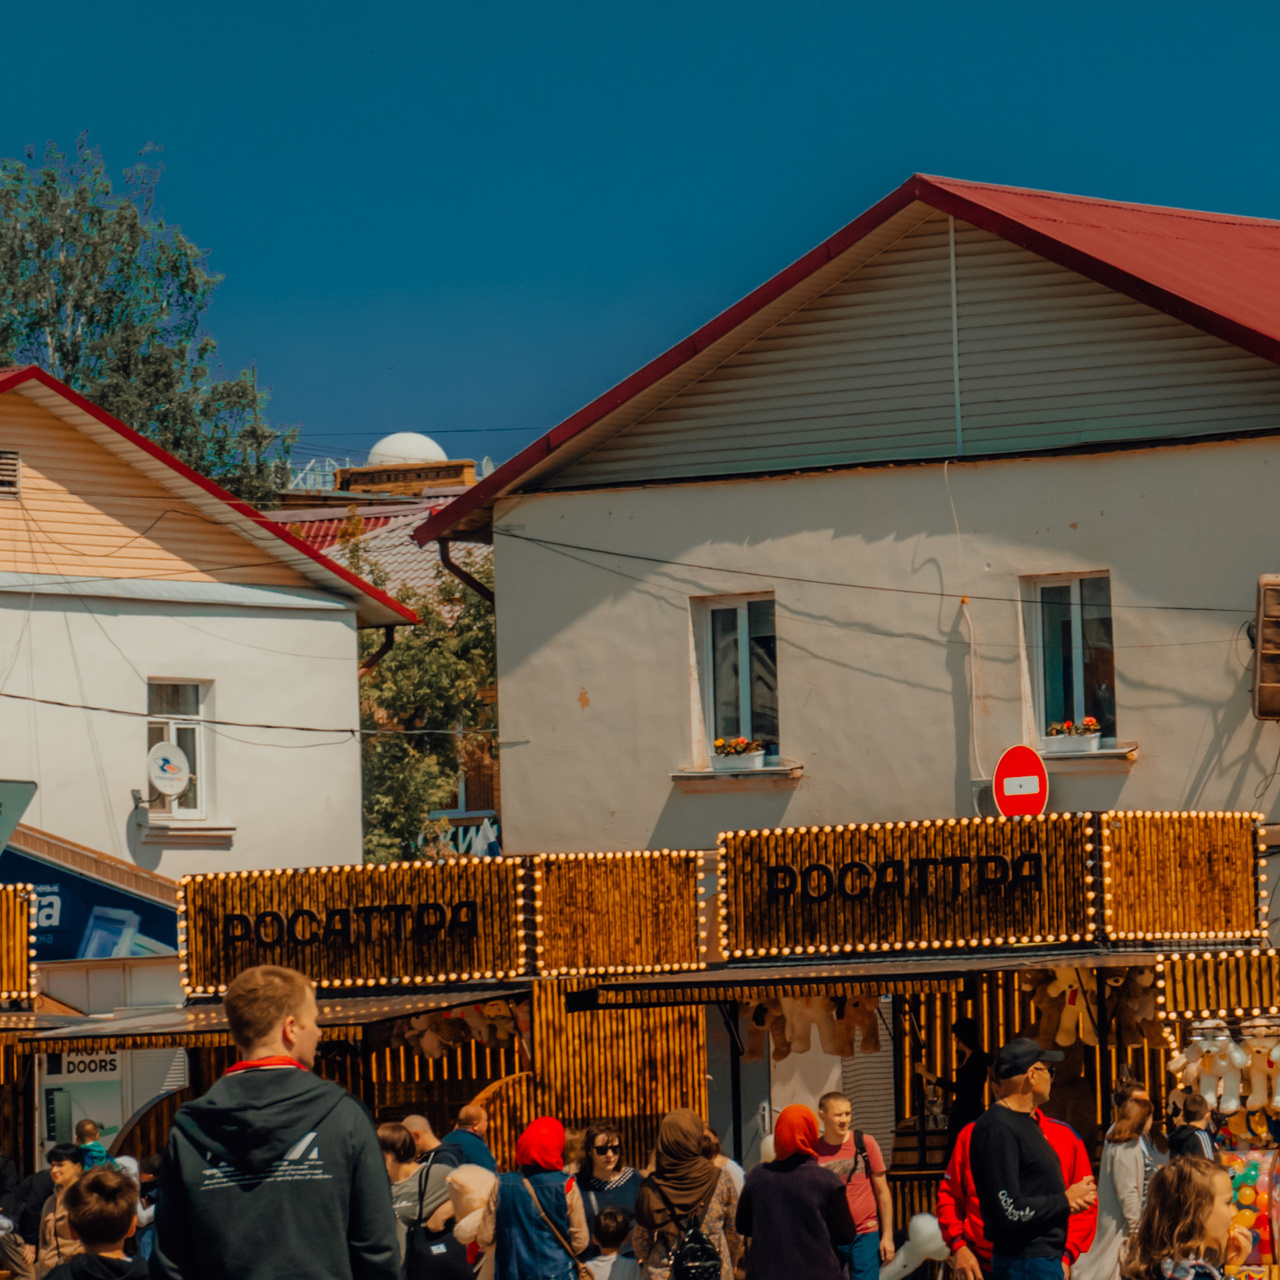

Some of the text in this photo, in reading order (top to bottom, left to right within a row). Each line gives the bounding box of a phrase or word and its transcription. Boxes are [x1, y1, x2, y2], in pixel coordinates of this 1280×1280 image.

[767, 852, 1043, 904] РОСАТТРА
[222, 900, 480, 951] РОСАТТРА
[66, 1058, 117, 1074] DOORS
